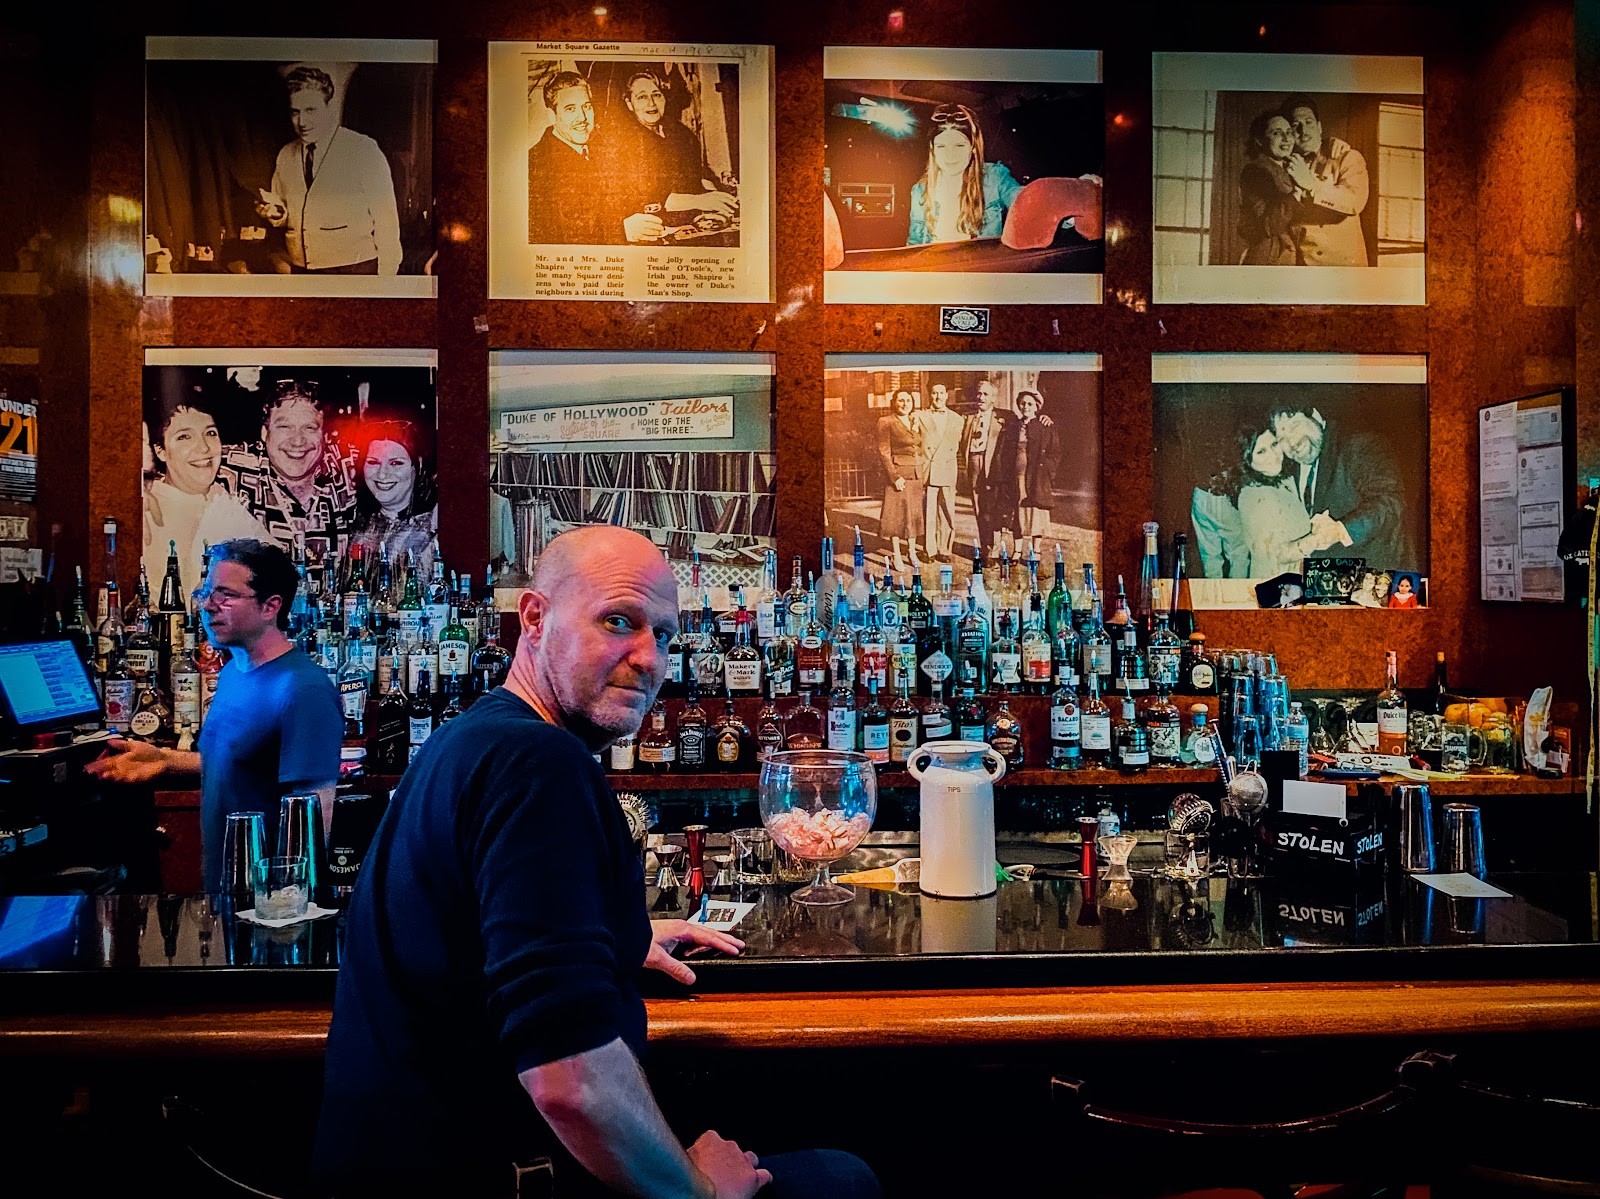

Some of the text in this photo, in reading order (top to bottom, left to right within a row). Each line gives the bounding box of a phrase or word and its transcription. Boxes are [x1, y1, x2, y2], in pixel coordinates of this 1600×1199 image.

[565, 43, 590, 51] Square
[666, 256, 684, 264] jolly
[691, 257, 720, 265] opening
[535, 263, 564, 271] Shapiro
[677, 264, 713, 272] O'Toole's,
[552, 272, 572, 280] many
[576, 272, 603, 280] Square
[544, 412, 556, 422] OF
[660, 400, 729, 416] Tailors
[637, 417, 691, 426] HOME OF THE
[0, 411, 38, 456] 21
[583, 430, 620, 439] SQUARE
[340, 680, 365, 692] APEROL
[893, 720, 913, 728] Tito's
[1278, 832, 1344, 855] STOLEN
[1357, 832, 1383, 854] STOLEN
[329, 863, 360, 873] JAMESON
